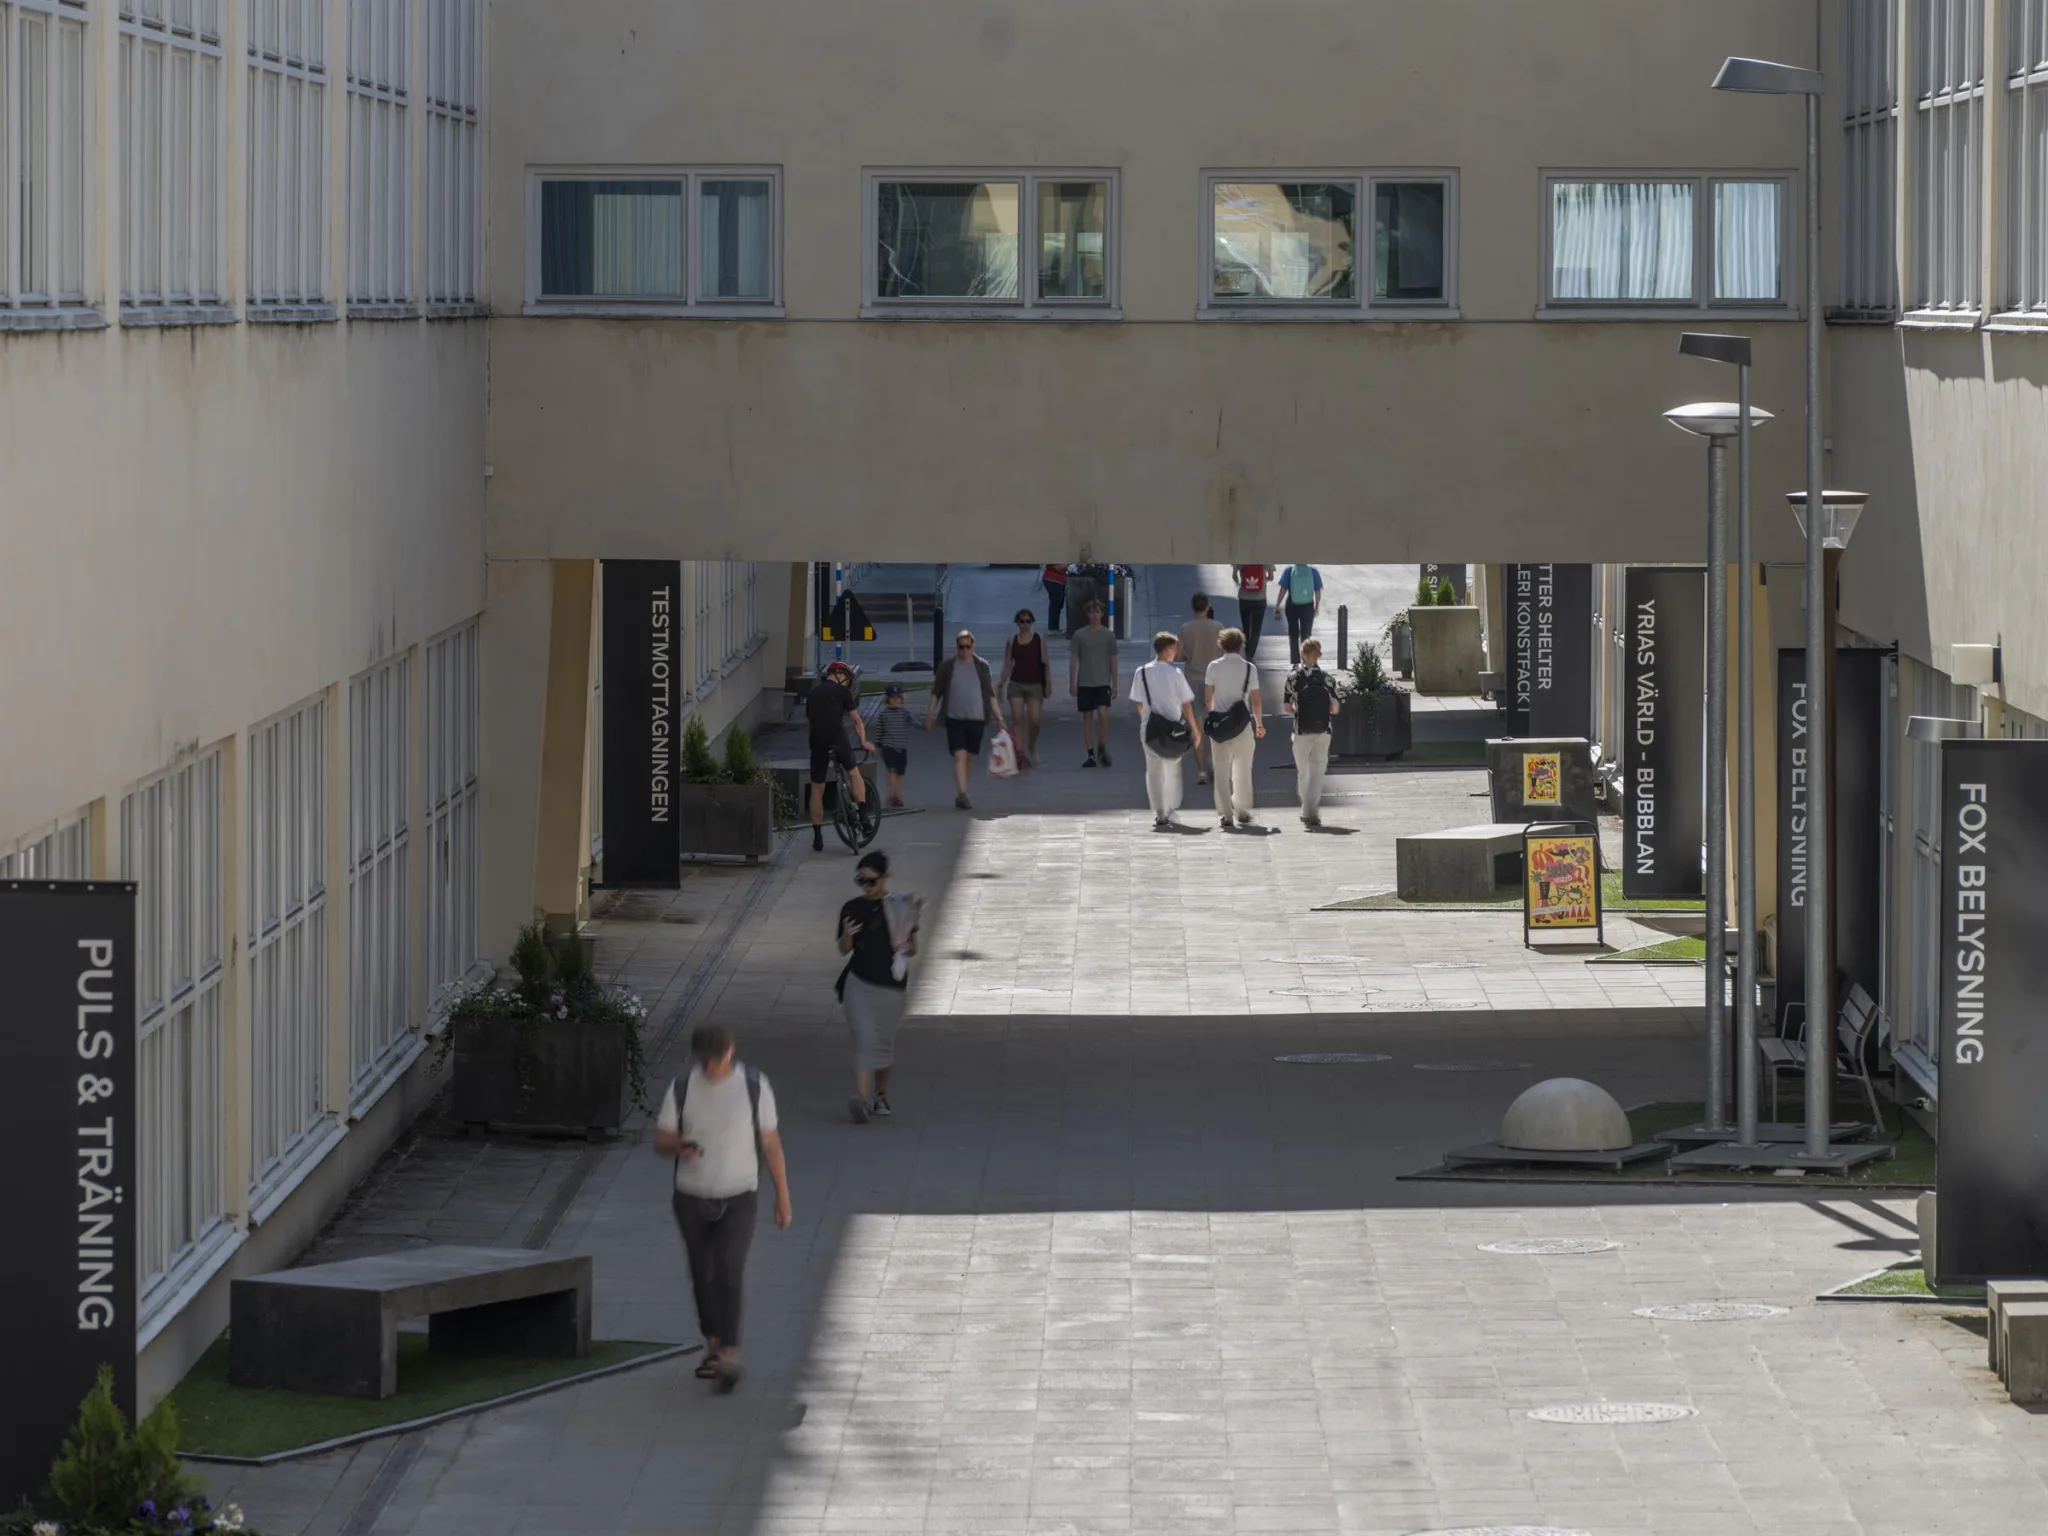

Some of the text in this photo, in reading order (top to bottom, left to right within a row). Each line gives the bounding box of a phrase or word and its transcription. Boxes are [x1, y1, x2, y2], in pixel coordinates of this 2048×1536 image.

[1517, 602, 1531, 703] KONSTFACK
[1538, 612, 1552, 690] SHELTER
[1637, 599, 1656, 666] YRIAS
[651, 585, 670, 822] TESTMOTTAGNINGEN
[1637, 671, 1659, 746] VÄRLD
[1637, 768, 1655, 875] BUBBLAN
[1956, 783, 1987, 1065] FOX BELYSNING
[77, 938, 123, 1330] PULS & TRÄNING
